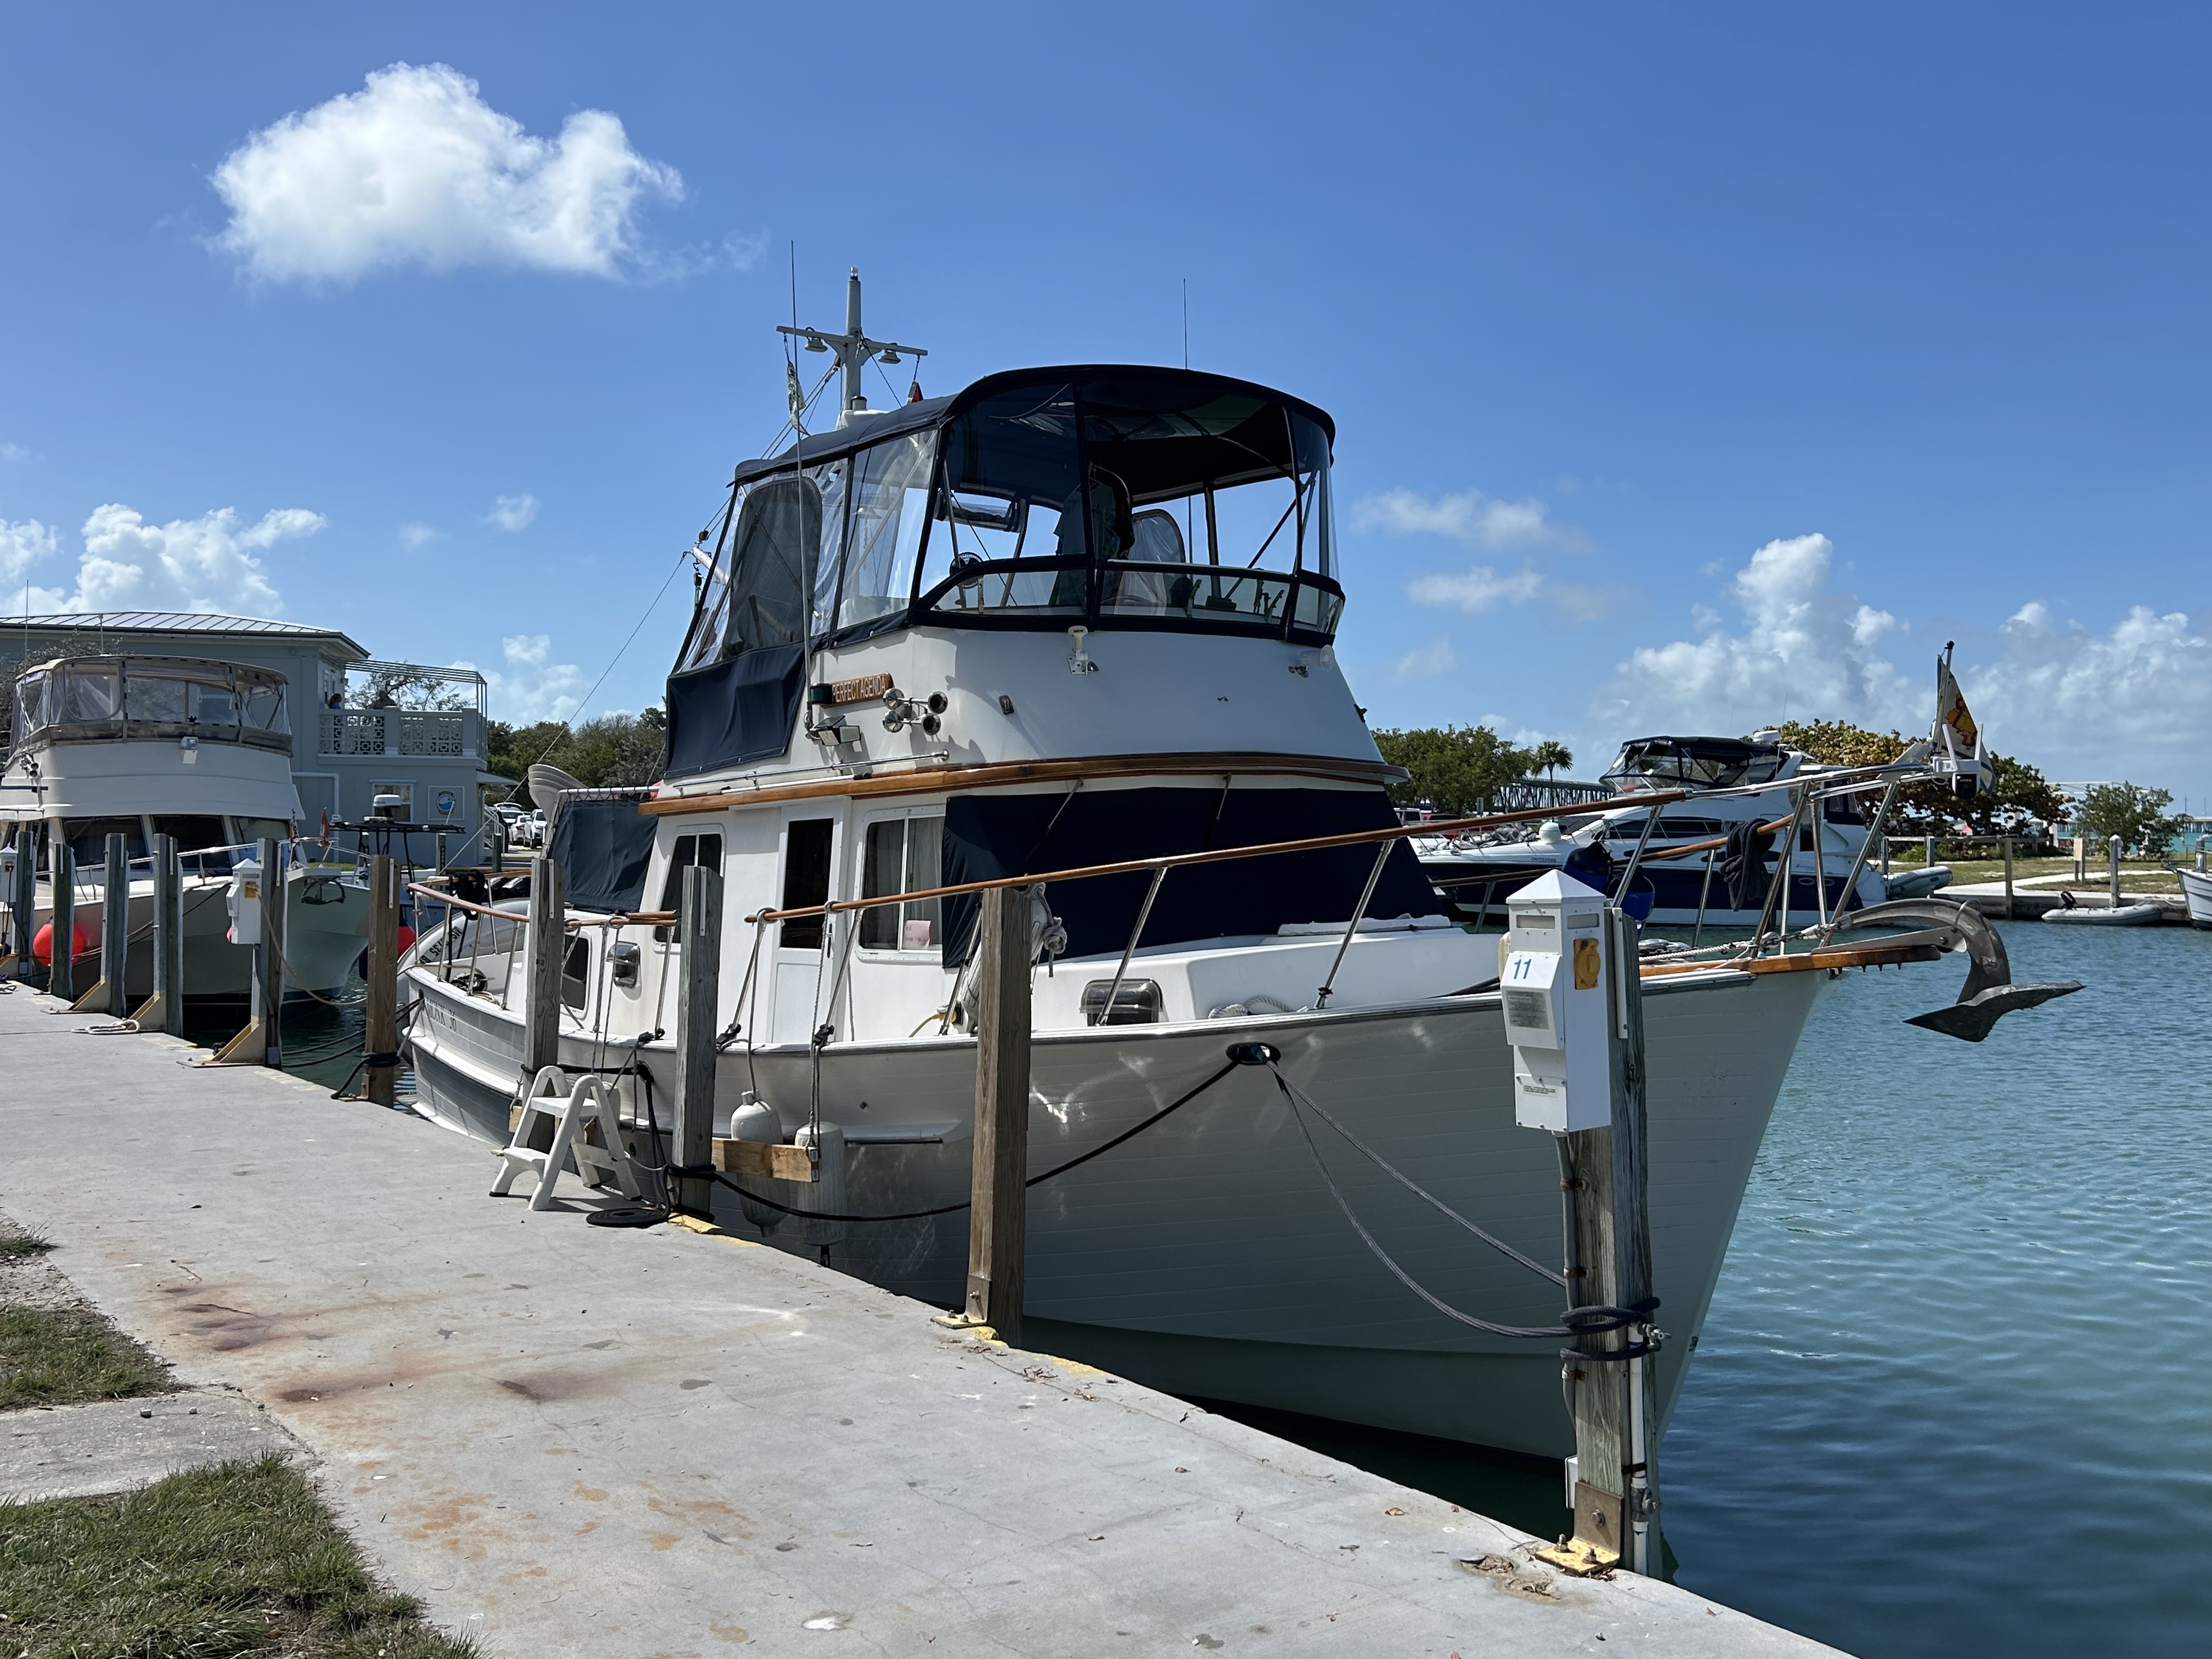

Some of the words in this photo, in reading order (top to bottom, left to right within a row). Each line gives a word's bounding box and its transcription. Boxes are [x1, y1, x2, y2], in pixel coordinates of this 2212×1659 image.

[832, 680, 859, 703] PERFECT
[860, 675, 886, 698] AGENDA
[1513, 958, 1532, 979] 11
